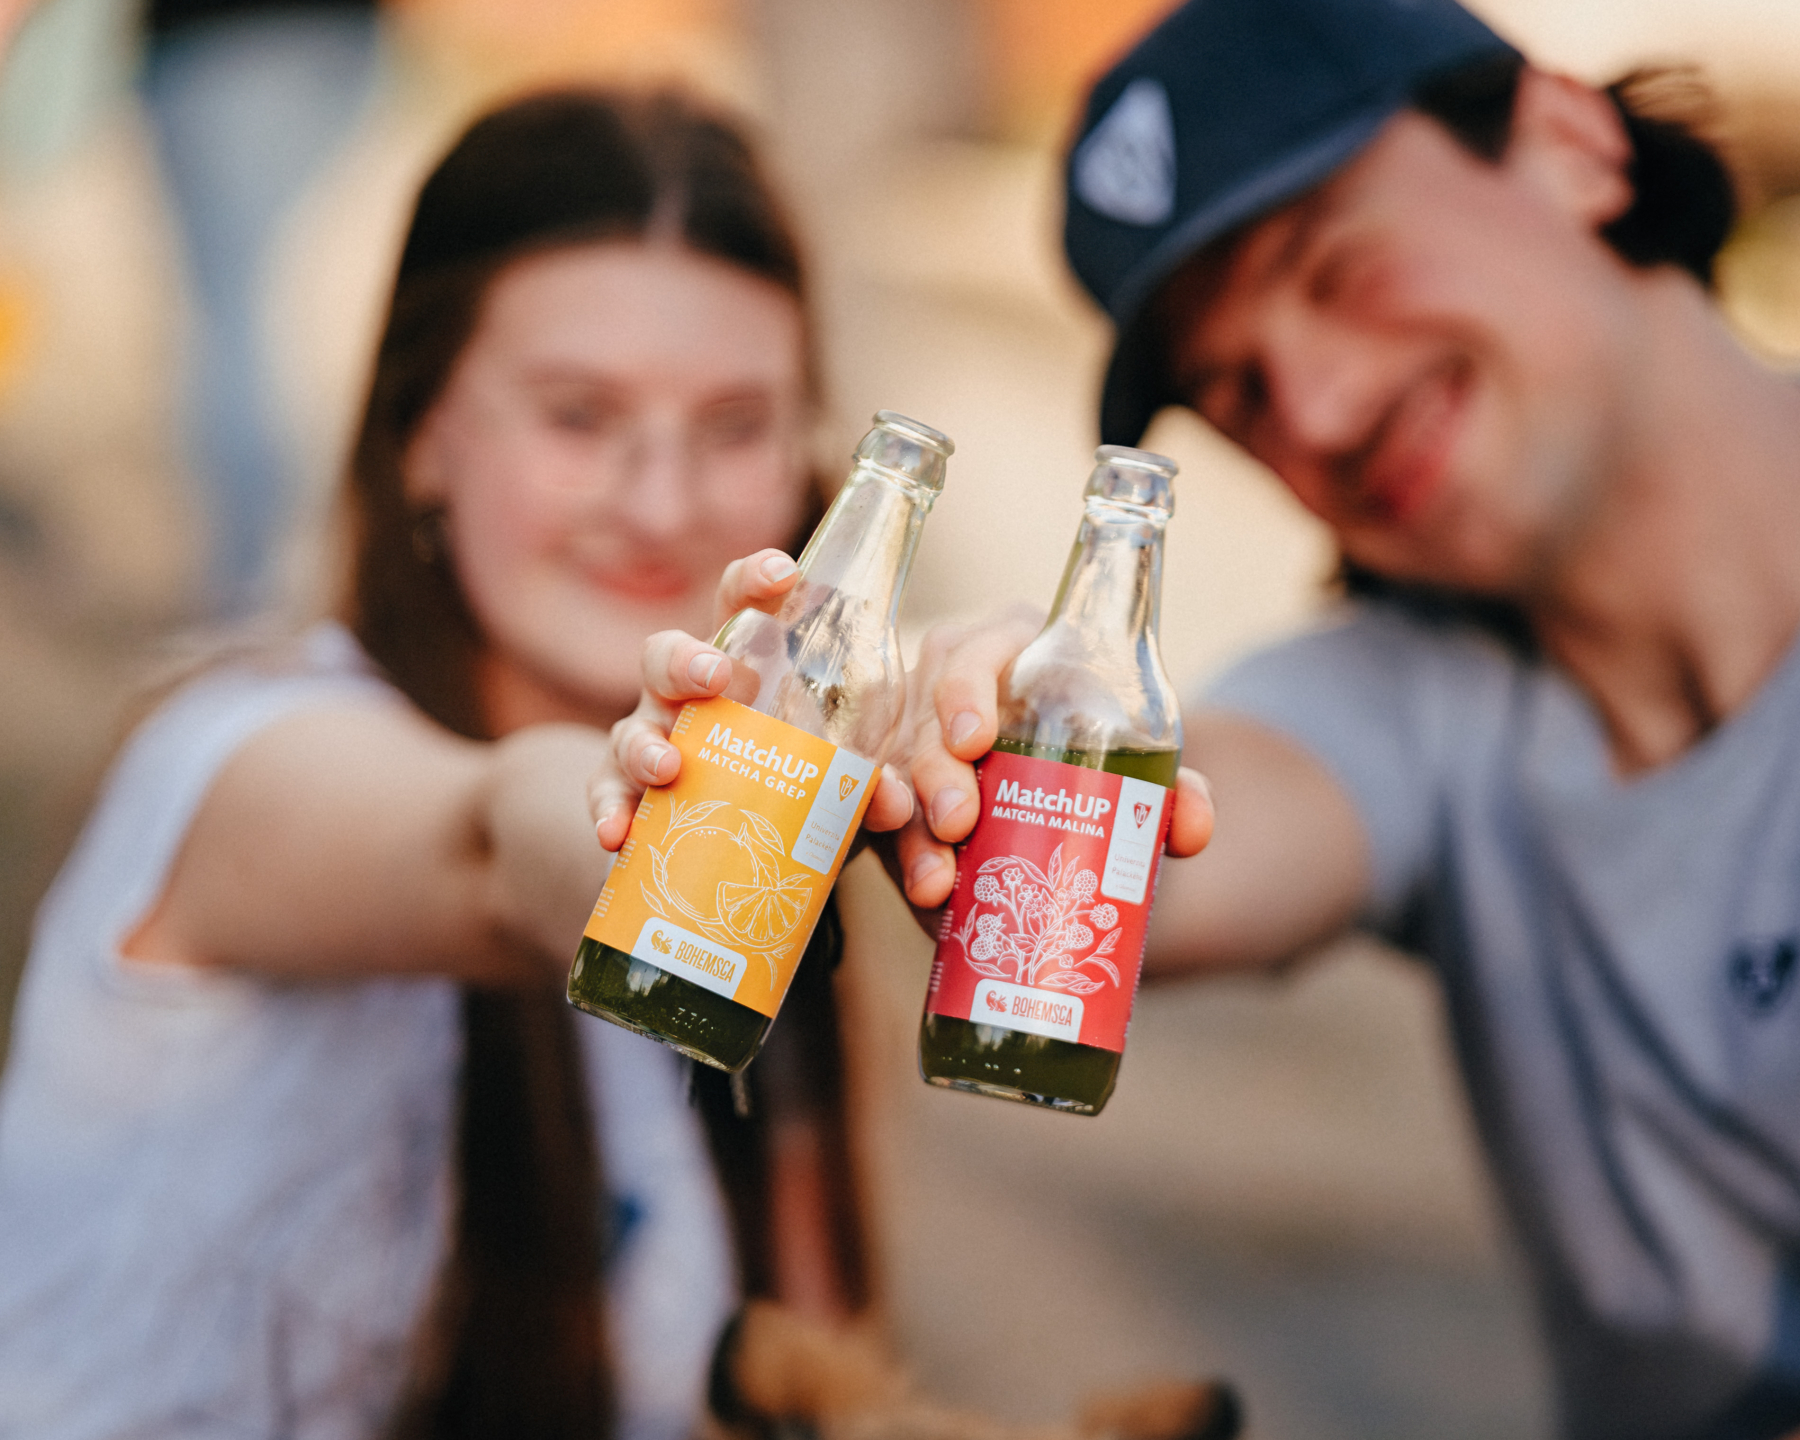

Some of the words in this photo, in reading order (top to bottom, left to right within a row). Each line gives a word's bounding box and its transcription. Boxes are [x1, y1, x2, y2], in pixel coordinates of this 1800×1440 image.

[698, 747, 760, 782] MATCHA
[764, 775, 806, 801] GREP
[705, 723, 819, 784] MatchUP
[995, 779, 1111, 820] MatchUP
[992, 805, 1045, 826] MATCHA
[1047, 814, 1105, 838] MALINA
[674, 940, 737, 983] BOHEMSCA
[1011, 995, 1073, 1027] BOHEMSCA
